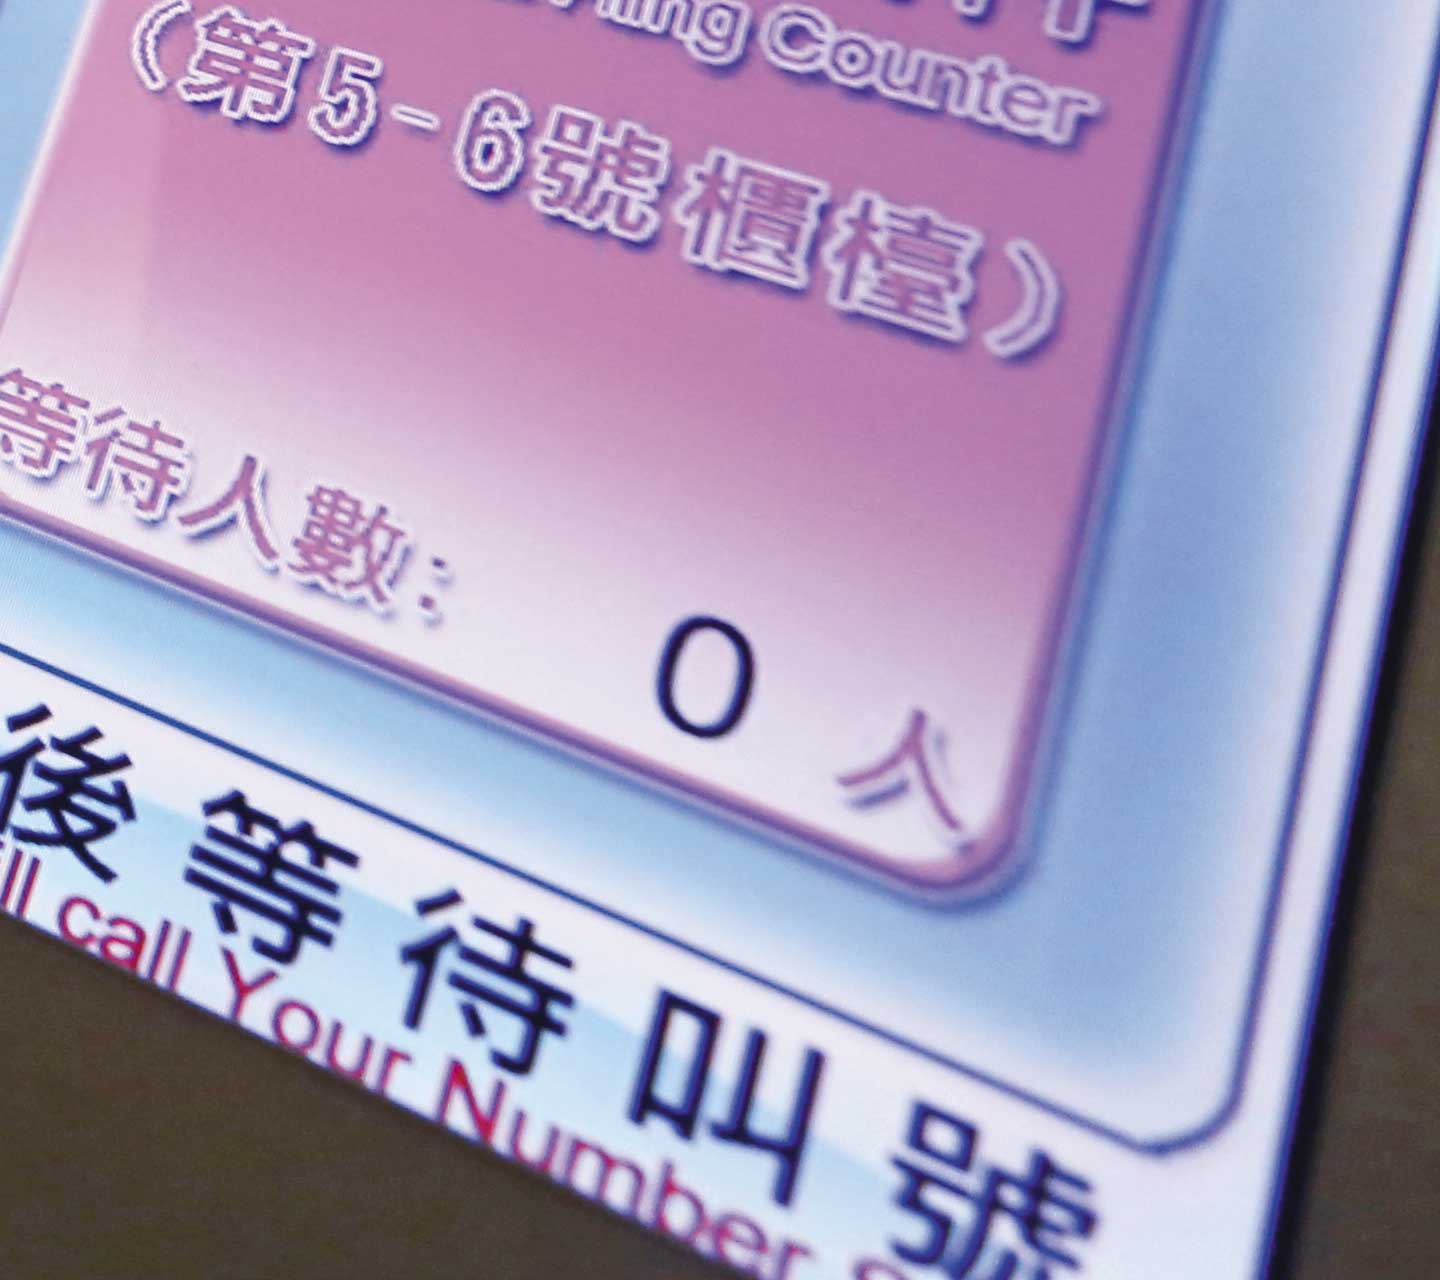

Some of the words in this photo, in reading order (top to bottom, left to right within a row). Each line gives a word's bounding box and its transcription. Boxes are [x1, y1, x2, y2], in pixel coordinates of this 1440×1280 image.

[759, 6, 1104, 149] Counter
[654, 614, 758, 741] 0
[835, 706, 966, 848] 人
[54, 891, 195, 995] call
[220, 943, 413, 1101] Your
[433, 1056, 813, 1280] Number
